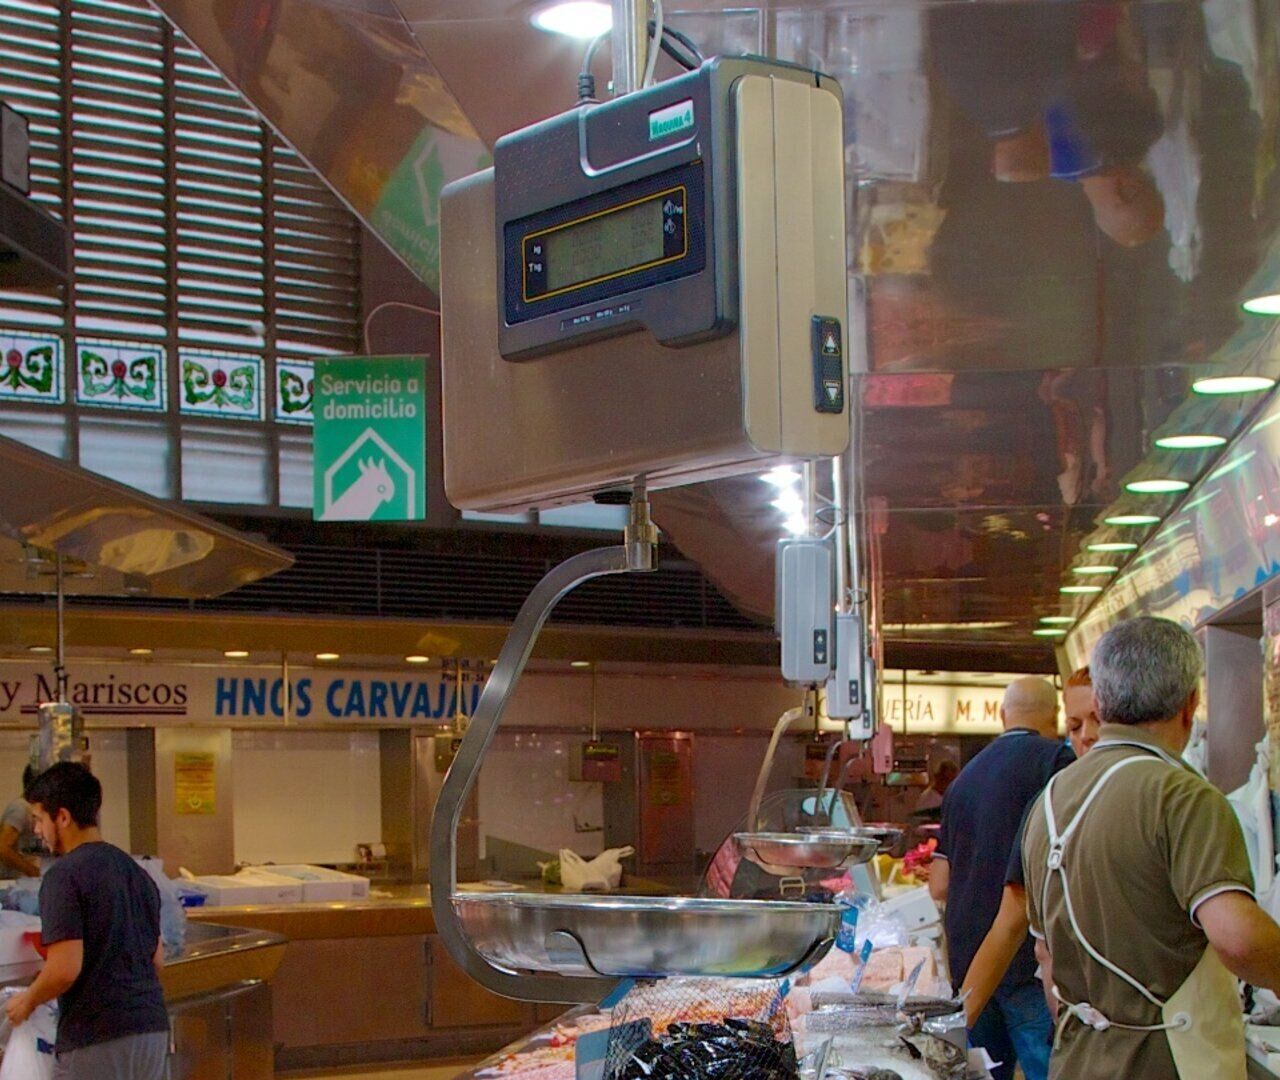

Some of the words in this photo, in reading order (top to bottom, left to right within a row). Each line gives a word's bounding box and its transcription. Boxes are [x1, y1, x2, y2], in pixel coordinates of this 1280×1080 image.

[321, 374, 401, 396] Servicio
[407, 379, 419, 394] a
[323, 398, 417, 420] domicilio
[0, 681, 20, 711] y
[35, 674, 188, 705] Mariscos
[215, 677, 312, 717] HNOS
